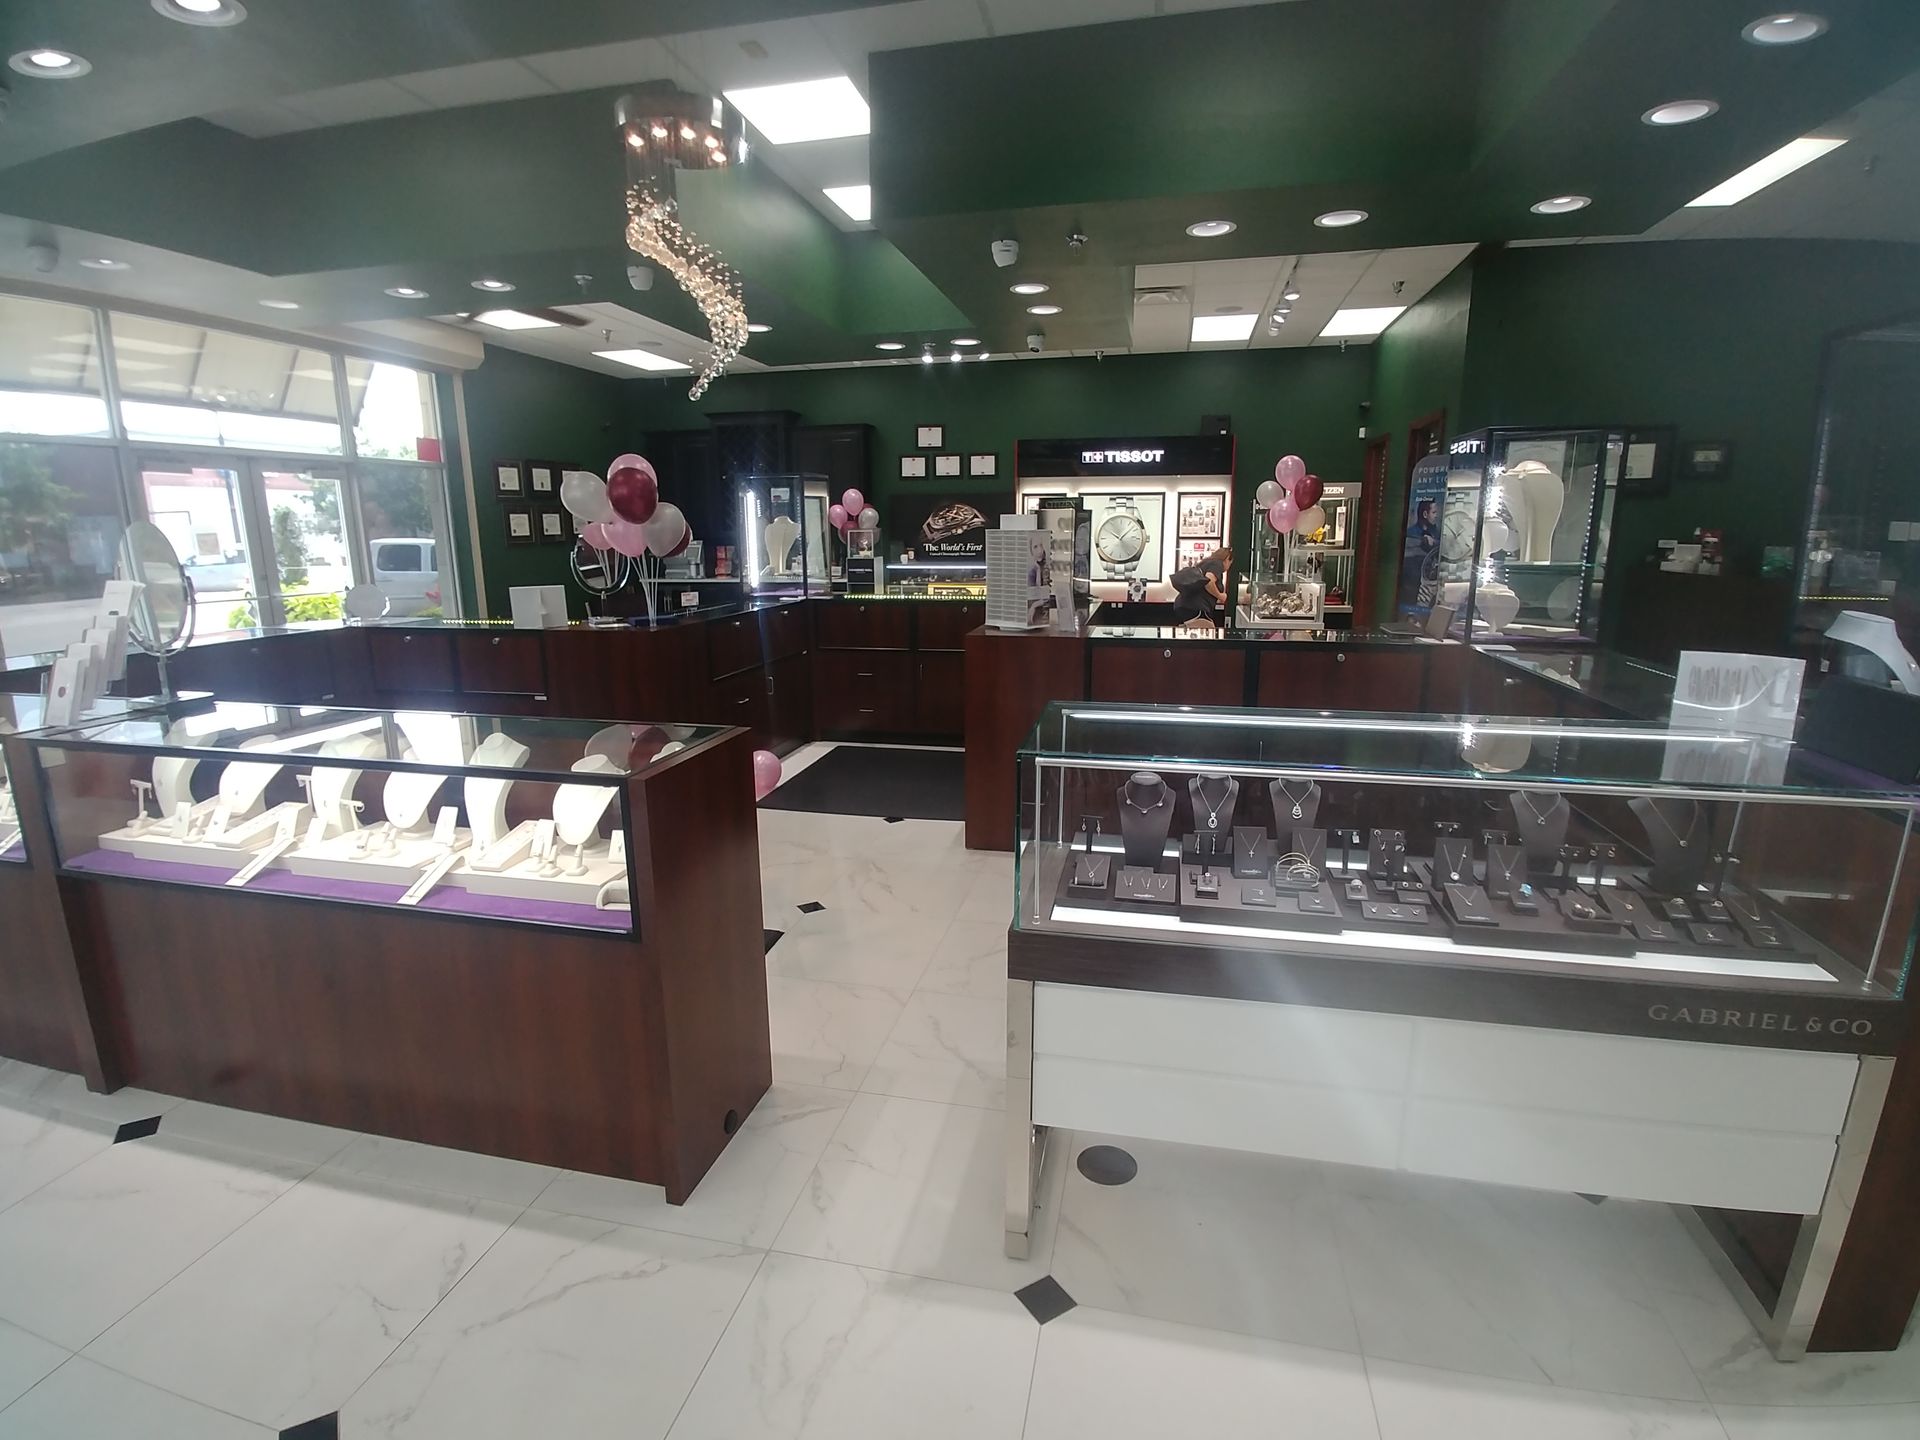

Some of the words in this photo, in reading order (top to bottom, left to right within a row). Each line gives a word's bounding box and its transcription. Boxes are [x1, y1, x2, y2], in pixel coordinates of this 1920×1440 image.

[1104, 450, 1165, 463] TISSOT
[923, 543, 939, 552] The
[941, 543, 965, 552] World's
[966, 543, 983, 552] First
[1647, 1004, 1798, 1032] GABRIEL
